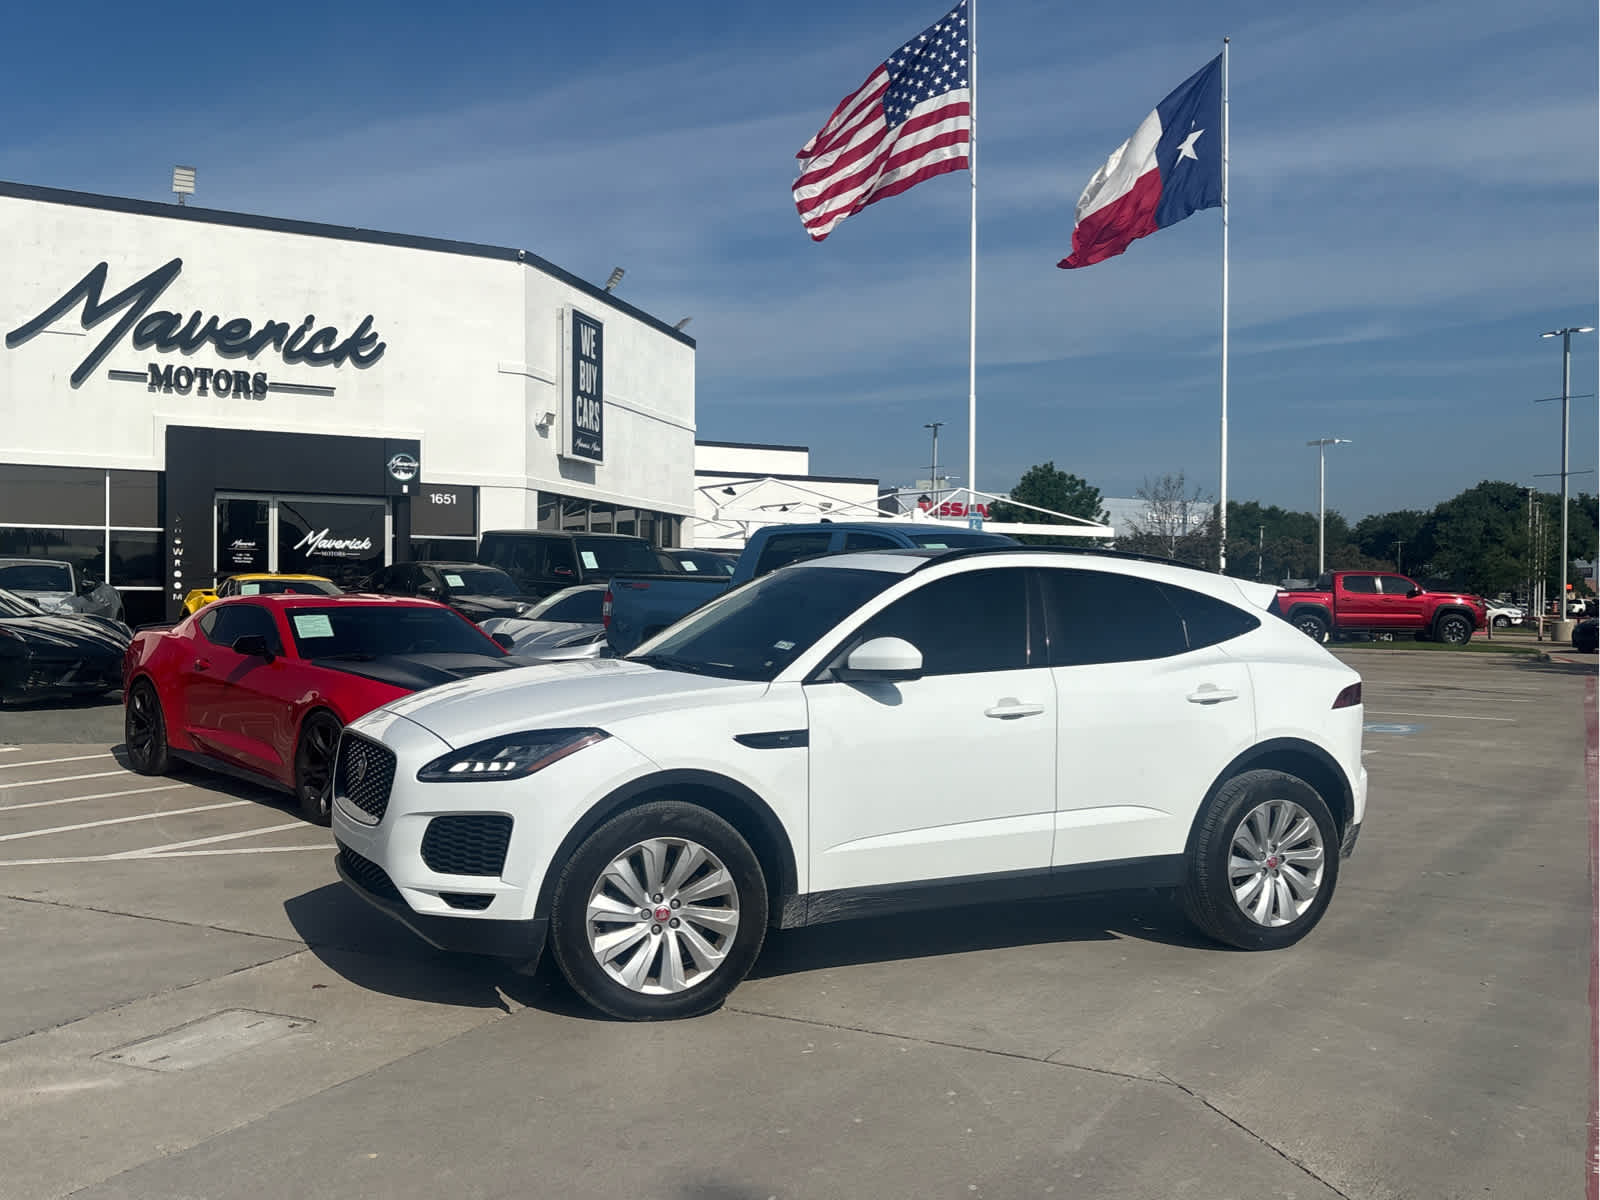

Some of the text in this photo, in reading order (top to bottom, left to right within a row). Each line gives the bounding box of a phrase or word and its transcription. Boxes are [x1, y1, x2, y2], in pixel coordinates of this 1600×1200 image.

[5, 257, 386, 390] Maverick
[580, 323, 597, 360] WE
[148, 362, 269, 400] MOTORS
[579, 360, 598, 396] BUY
[576, 395, 600, 433] CARS
[429, 493, 457, 505] 1651
[172, 512, 184, 601] OWROOM
[293, 528, 372, 557] Maverick
